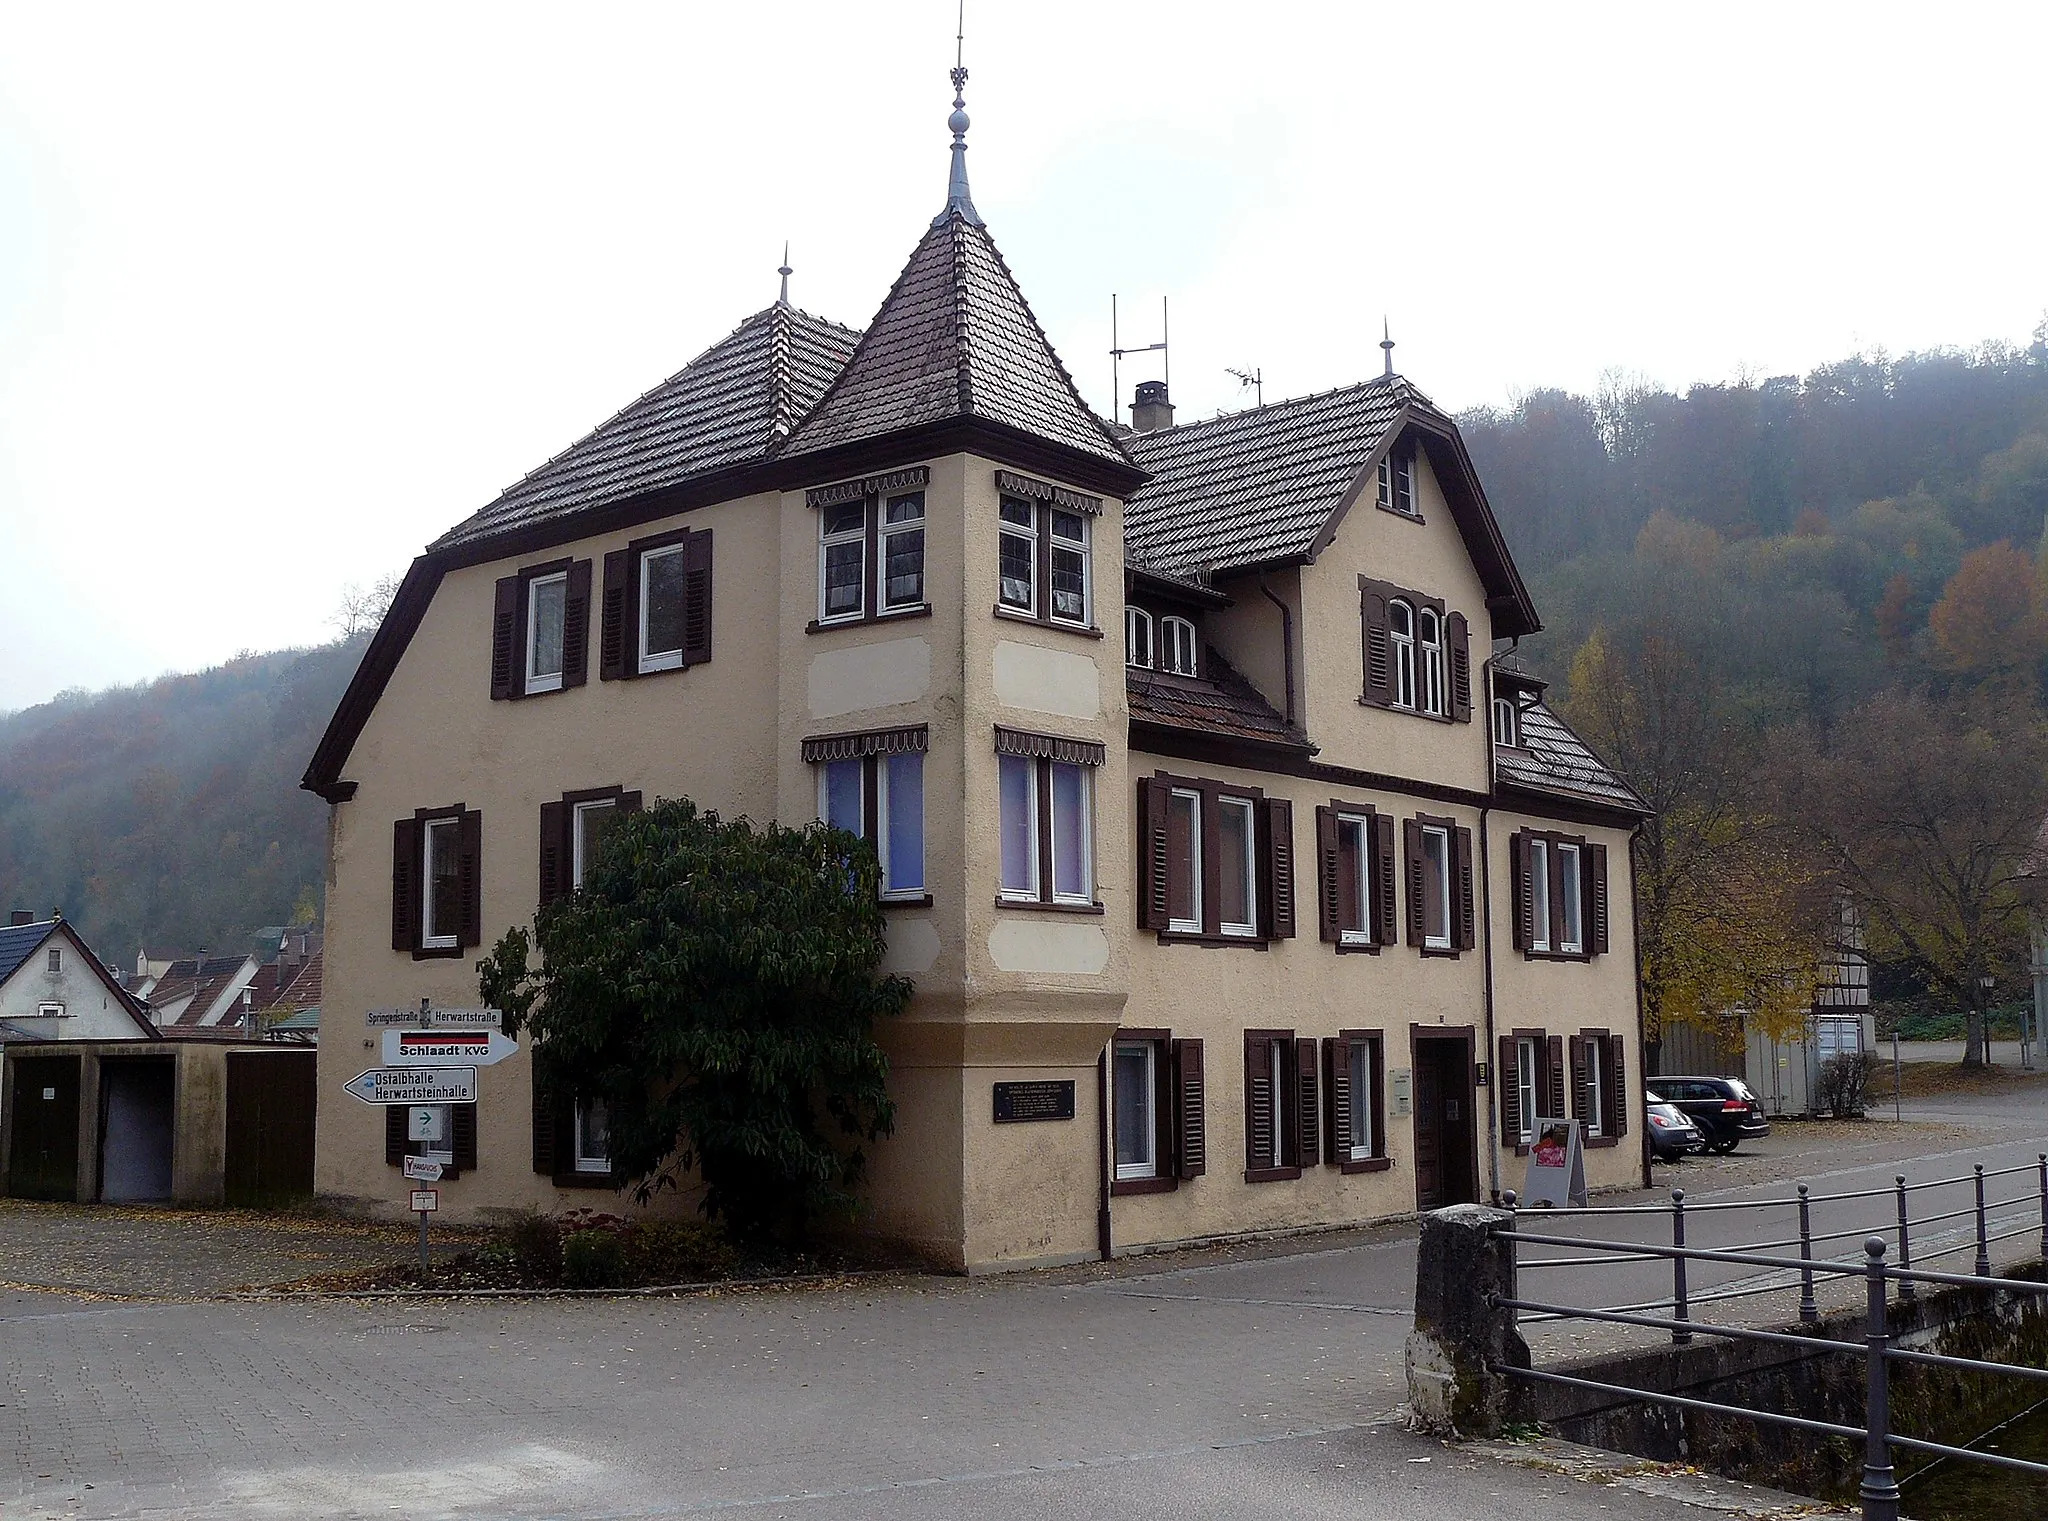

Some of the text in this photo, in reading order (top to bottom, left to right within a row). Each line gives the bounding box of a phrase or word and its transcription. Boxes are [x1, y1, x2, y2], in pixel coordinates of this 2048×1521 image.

[435, 1011, 497, 1022] Herwartstraße
[400, 1046, 489, 1056] Schlaadt KVG
[375, 1073, 434, 1085] Ostalbhalle
[375, 1085, 468, 1099] Herwartsteinhalle
